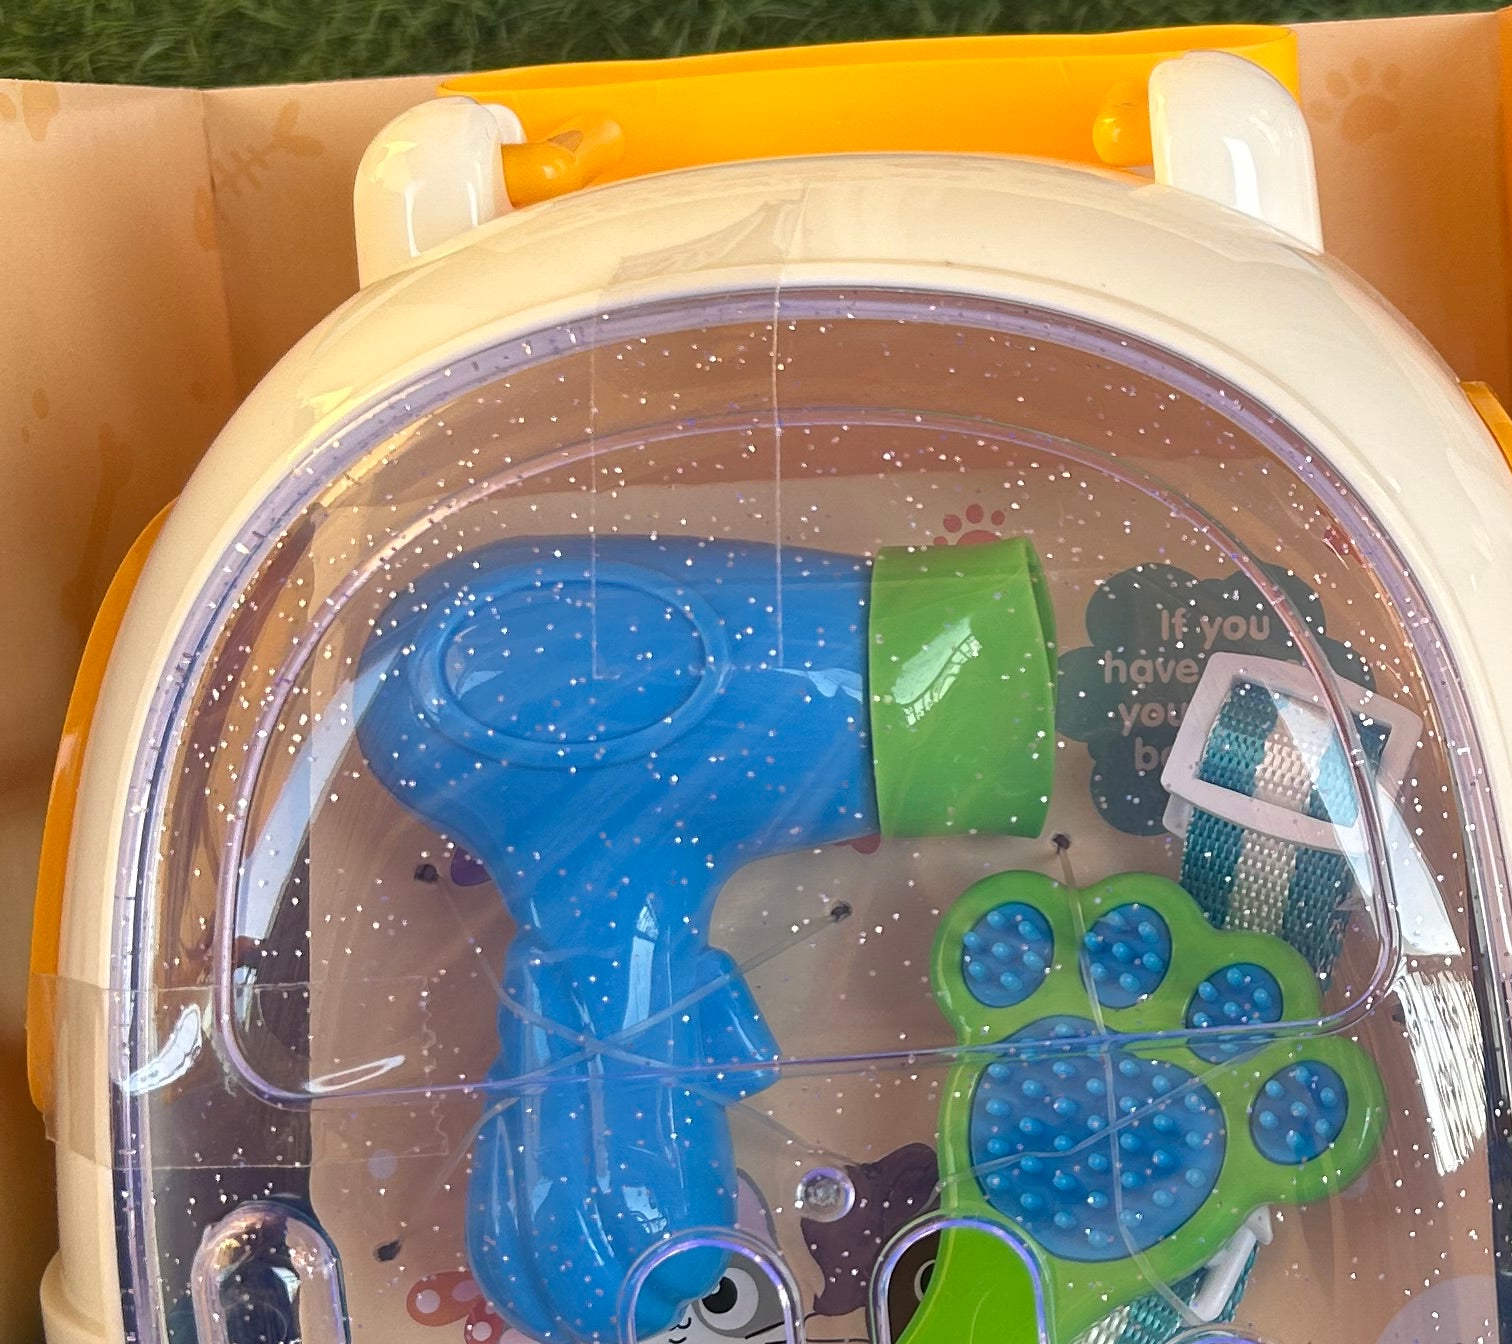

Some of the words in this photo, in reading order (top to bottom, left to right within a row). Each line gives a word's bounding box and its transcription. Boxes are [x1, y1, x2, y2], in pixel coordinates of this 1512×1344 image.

[1160, 607, 1187, 642] If
[1200, 615, 1271, 651] you
[1104, 650, 1200, 684] have
